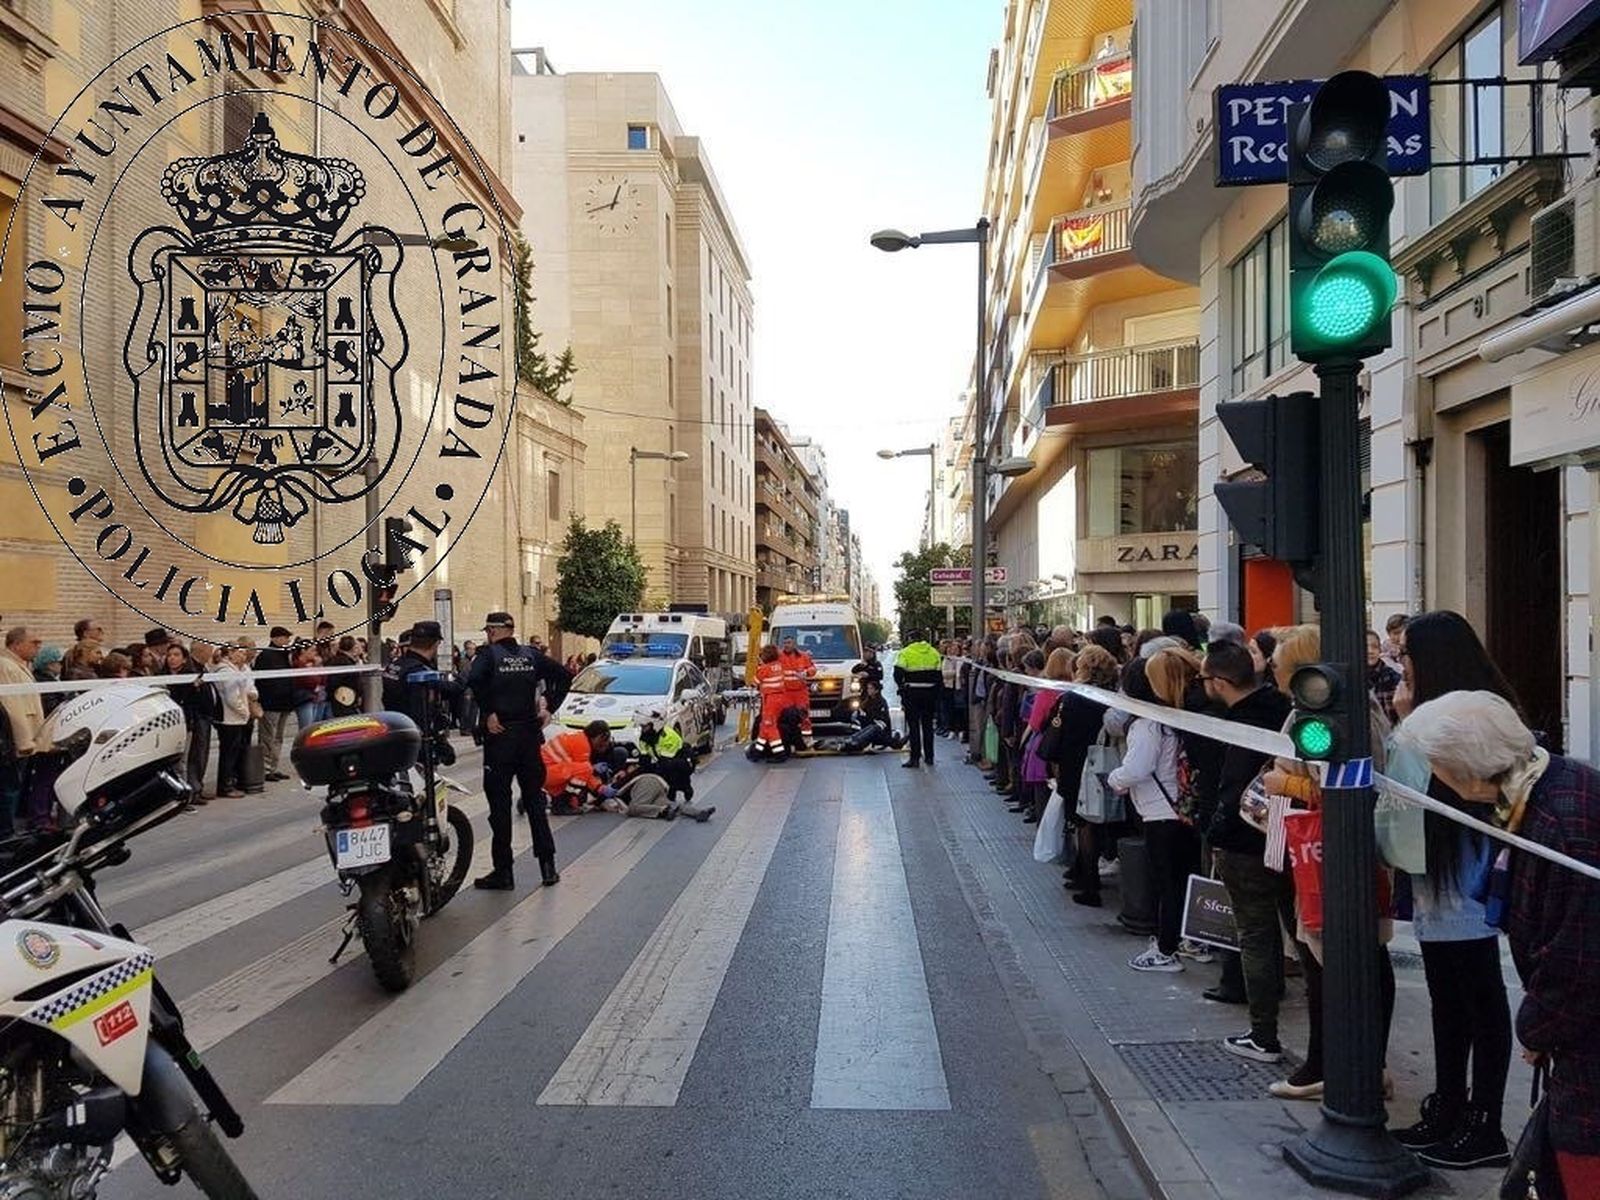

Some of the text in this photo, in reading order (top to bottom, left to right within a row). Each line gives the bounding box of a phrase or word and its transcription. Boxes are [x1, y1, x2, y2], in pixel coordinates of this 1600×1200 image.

[1117, 544, 1198, 562] ZARA
[351, 826, 386, 846] 8447
[107, 1005, 133, 1028] 112
